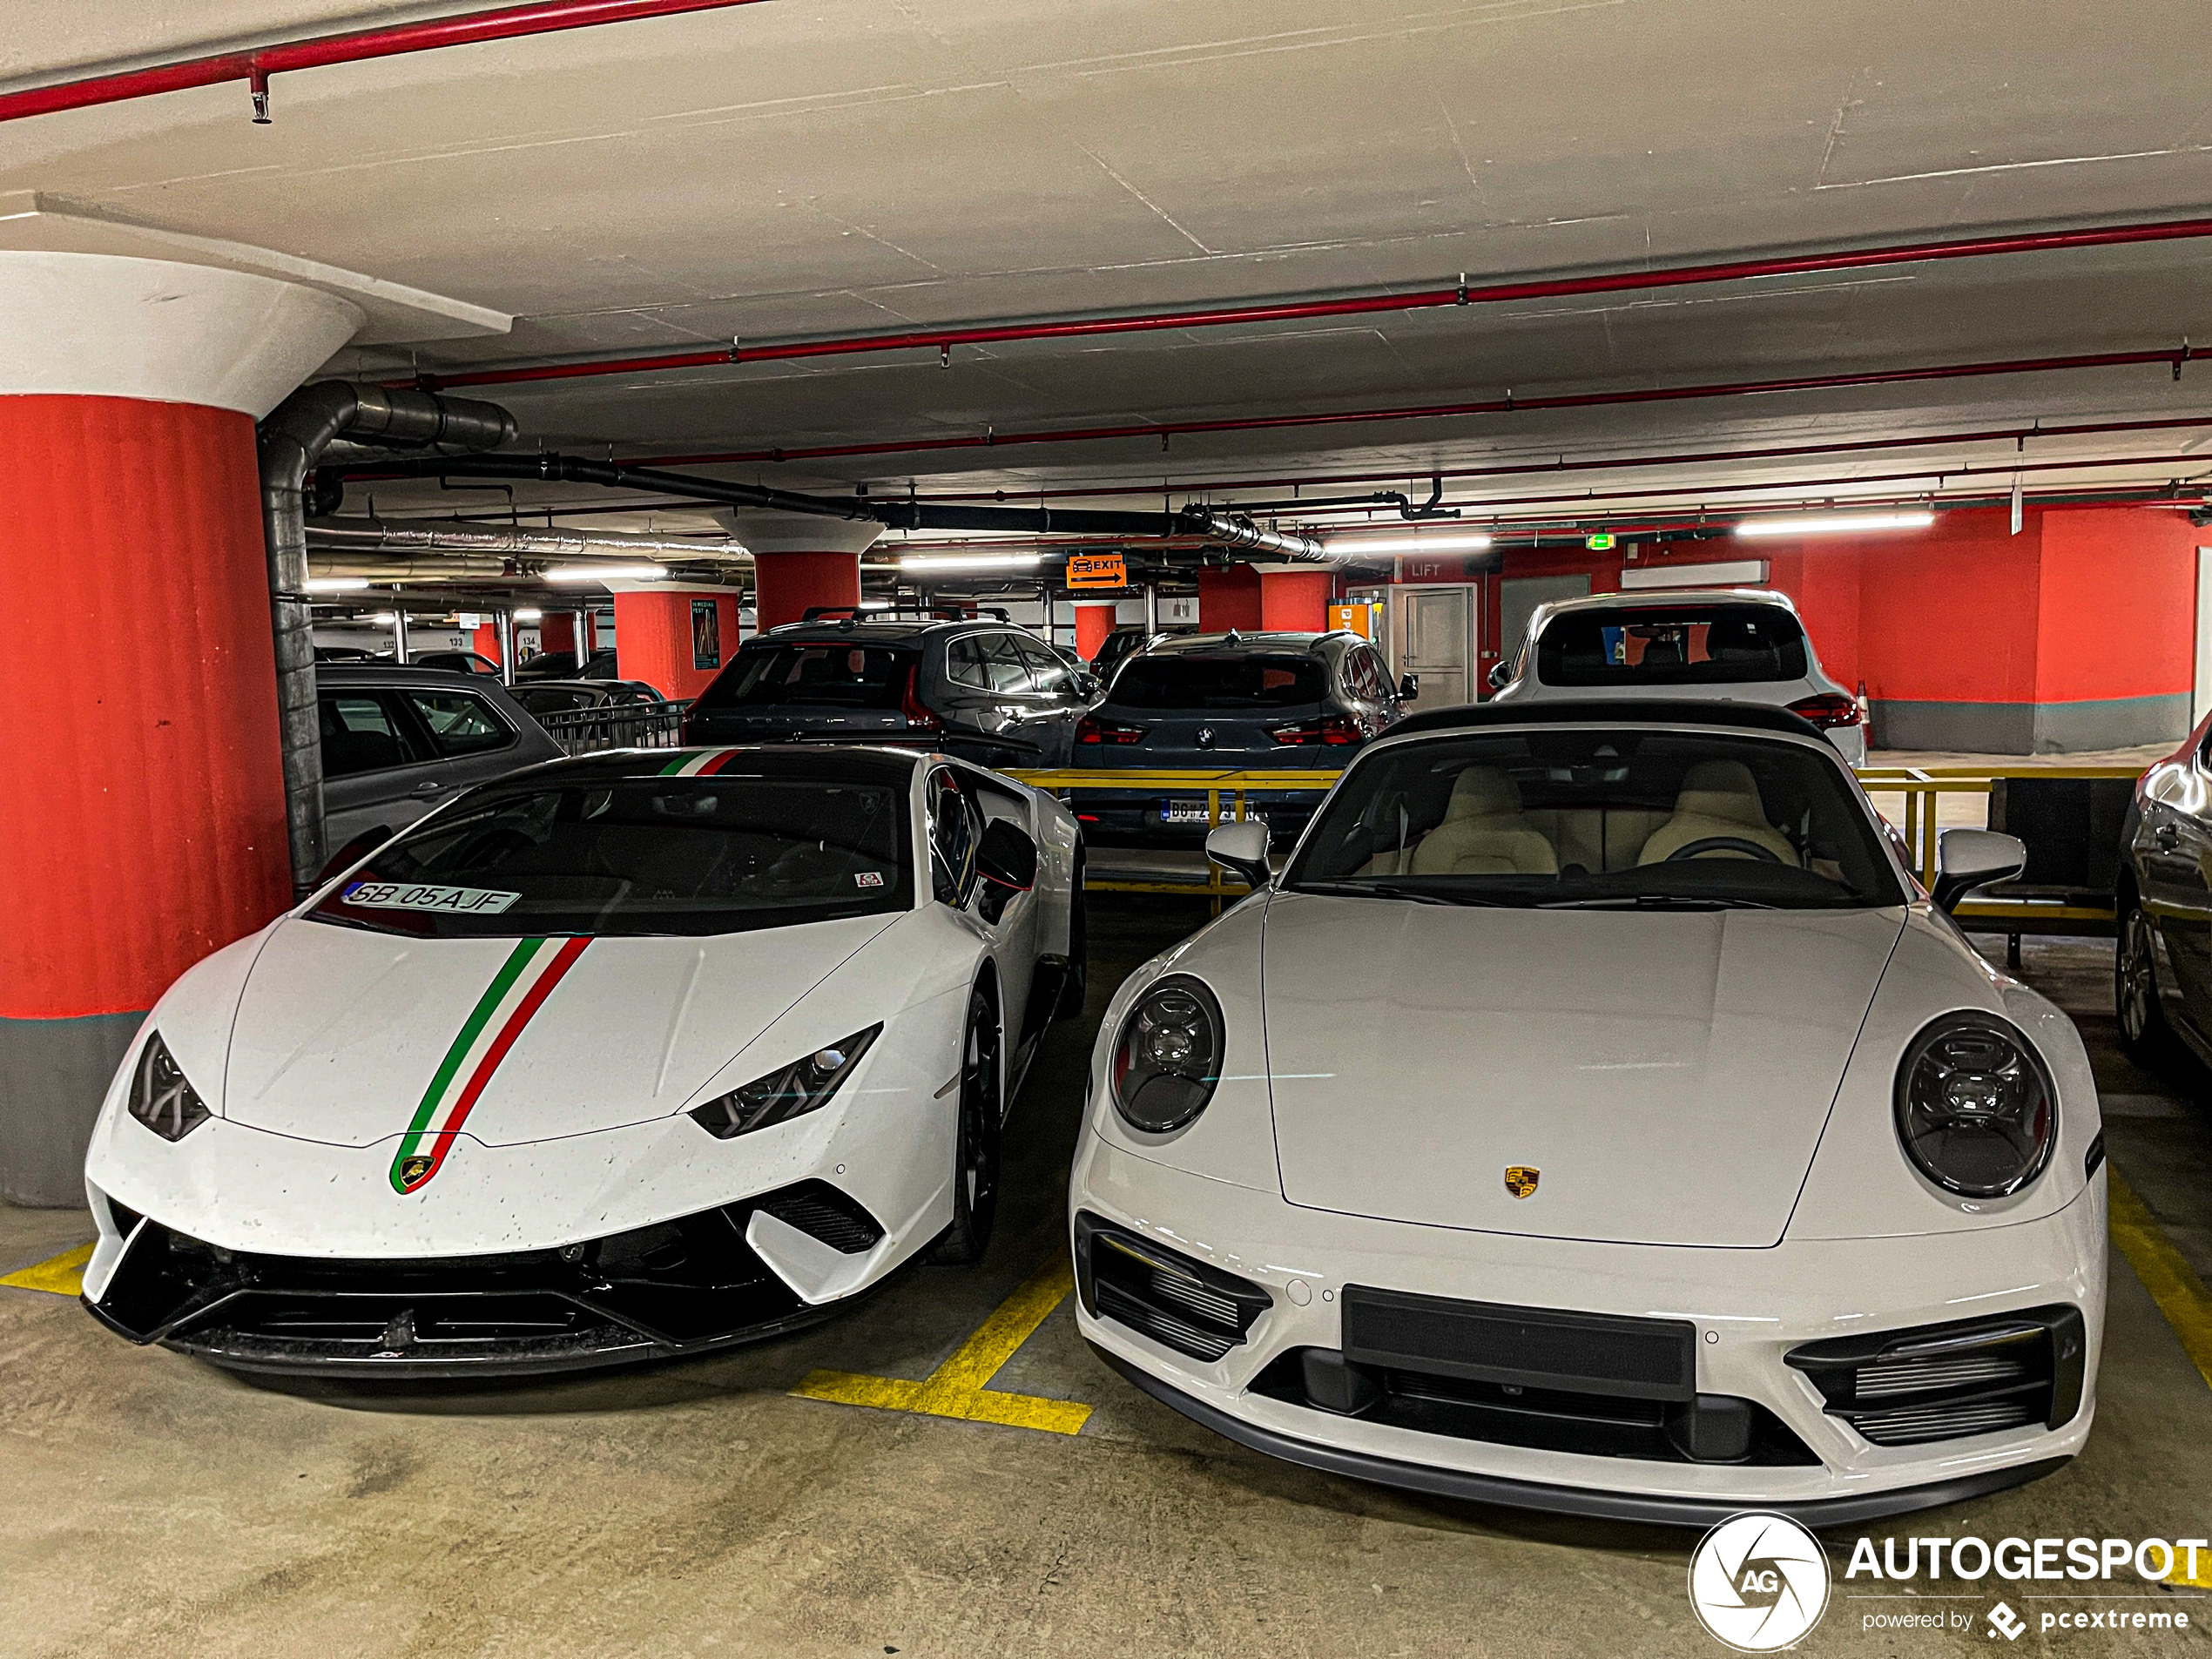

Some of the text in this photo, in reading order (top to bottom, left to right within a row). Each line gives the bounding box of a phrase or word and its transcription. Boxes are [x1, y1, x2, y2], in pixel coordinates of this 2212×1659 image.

[1094, 560, 1122, 570] EXIT
[1412, 563, 1440, 577] LIFT
[449, 638, 463, 647] 133
[1172, 802, 1189, 818] BG
[348, 885, 399, 902] SB
